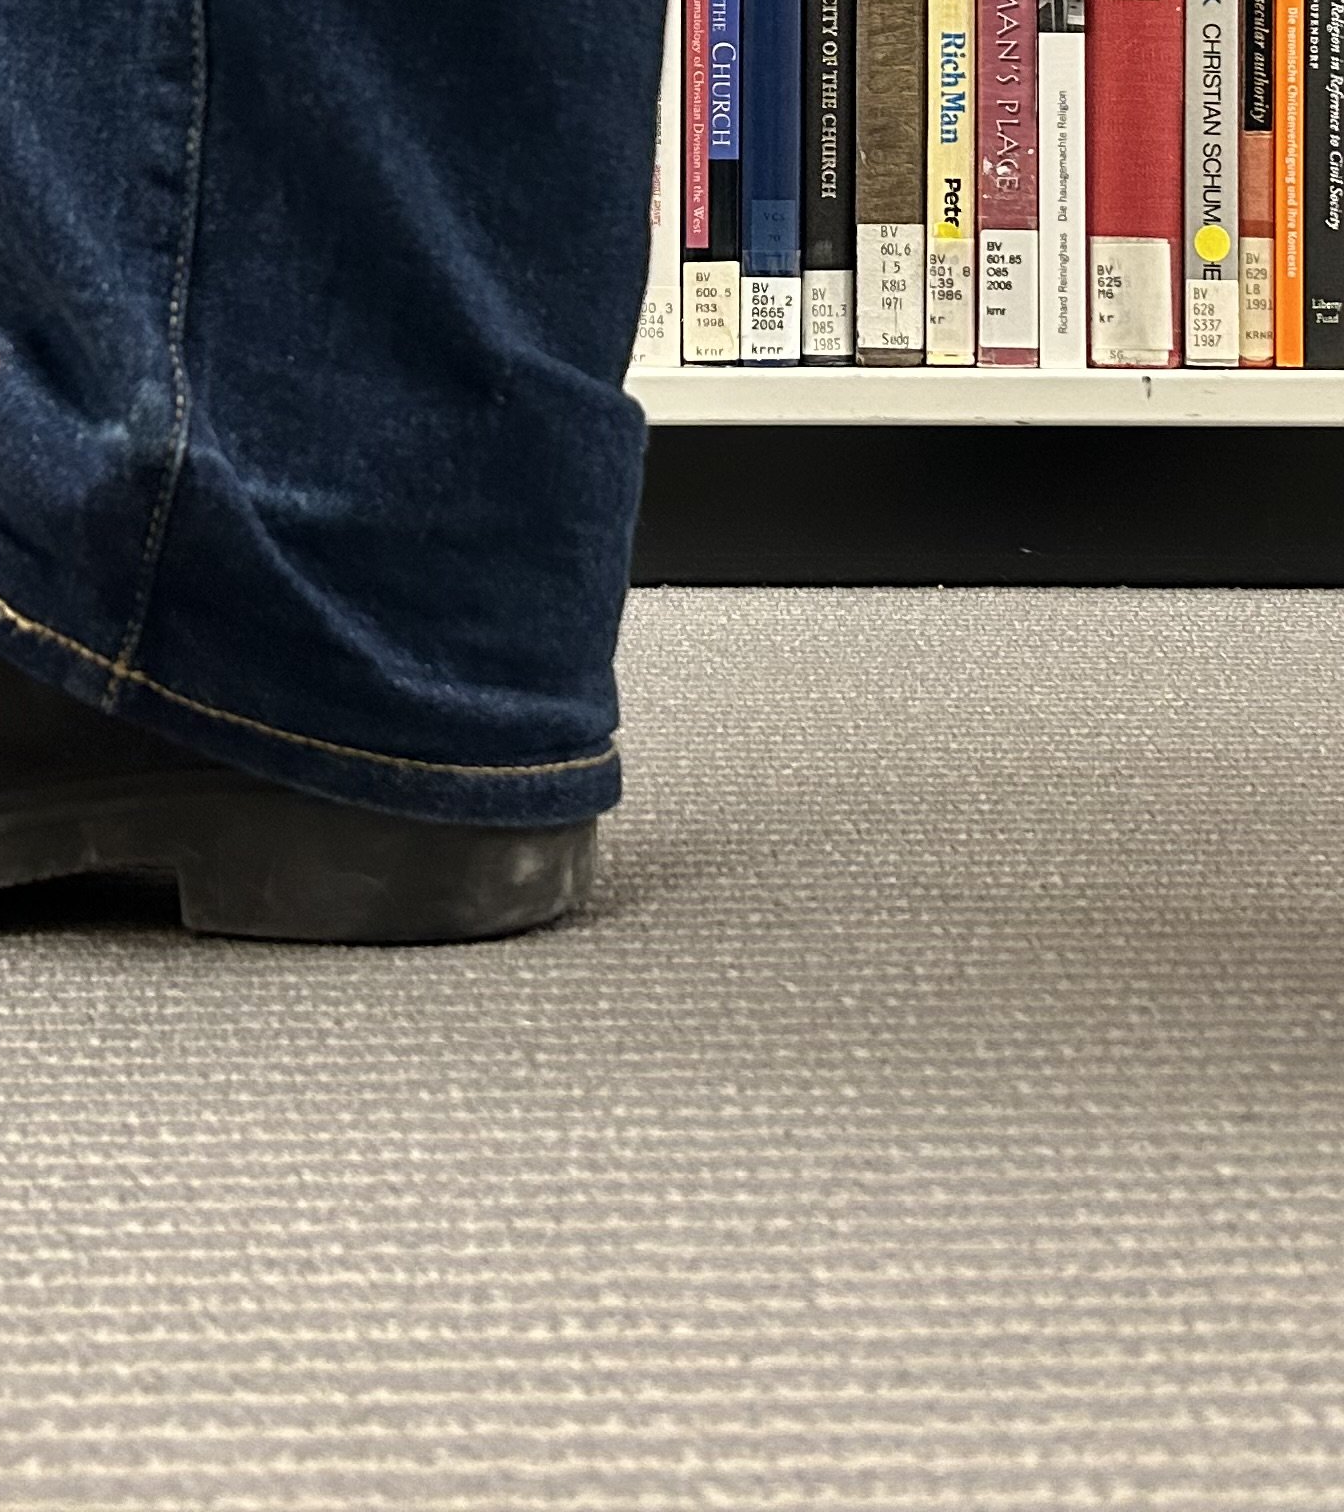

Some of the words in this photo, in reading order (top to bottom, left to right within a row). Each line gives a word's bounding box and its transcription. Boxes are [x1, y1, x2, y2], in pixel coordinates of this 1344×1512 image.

[713, 0, 727, 31] THE
[823, 41, 838, 66] OF
[941, 33, 966, 87] Rich
[711, 41, 736, 145] CHURCH
[822, 70, 838, 108] THE
[1203, 24, 1221, 135] CHRISTIAN
[941, 92, 965, 144] Man
[821, 114, 836, 198] CHURCH
[992, 100, 1021, 192] PLACE
[752, 283, 768, 293] BV
[752, 307, 784, 318] A665
[752, 319, 783, 330] 2004
[752, 344, 783, 354] krnr
